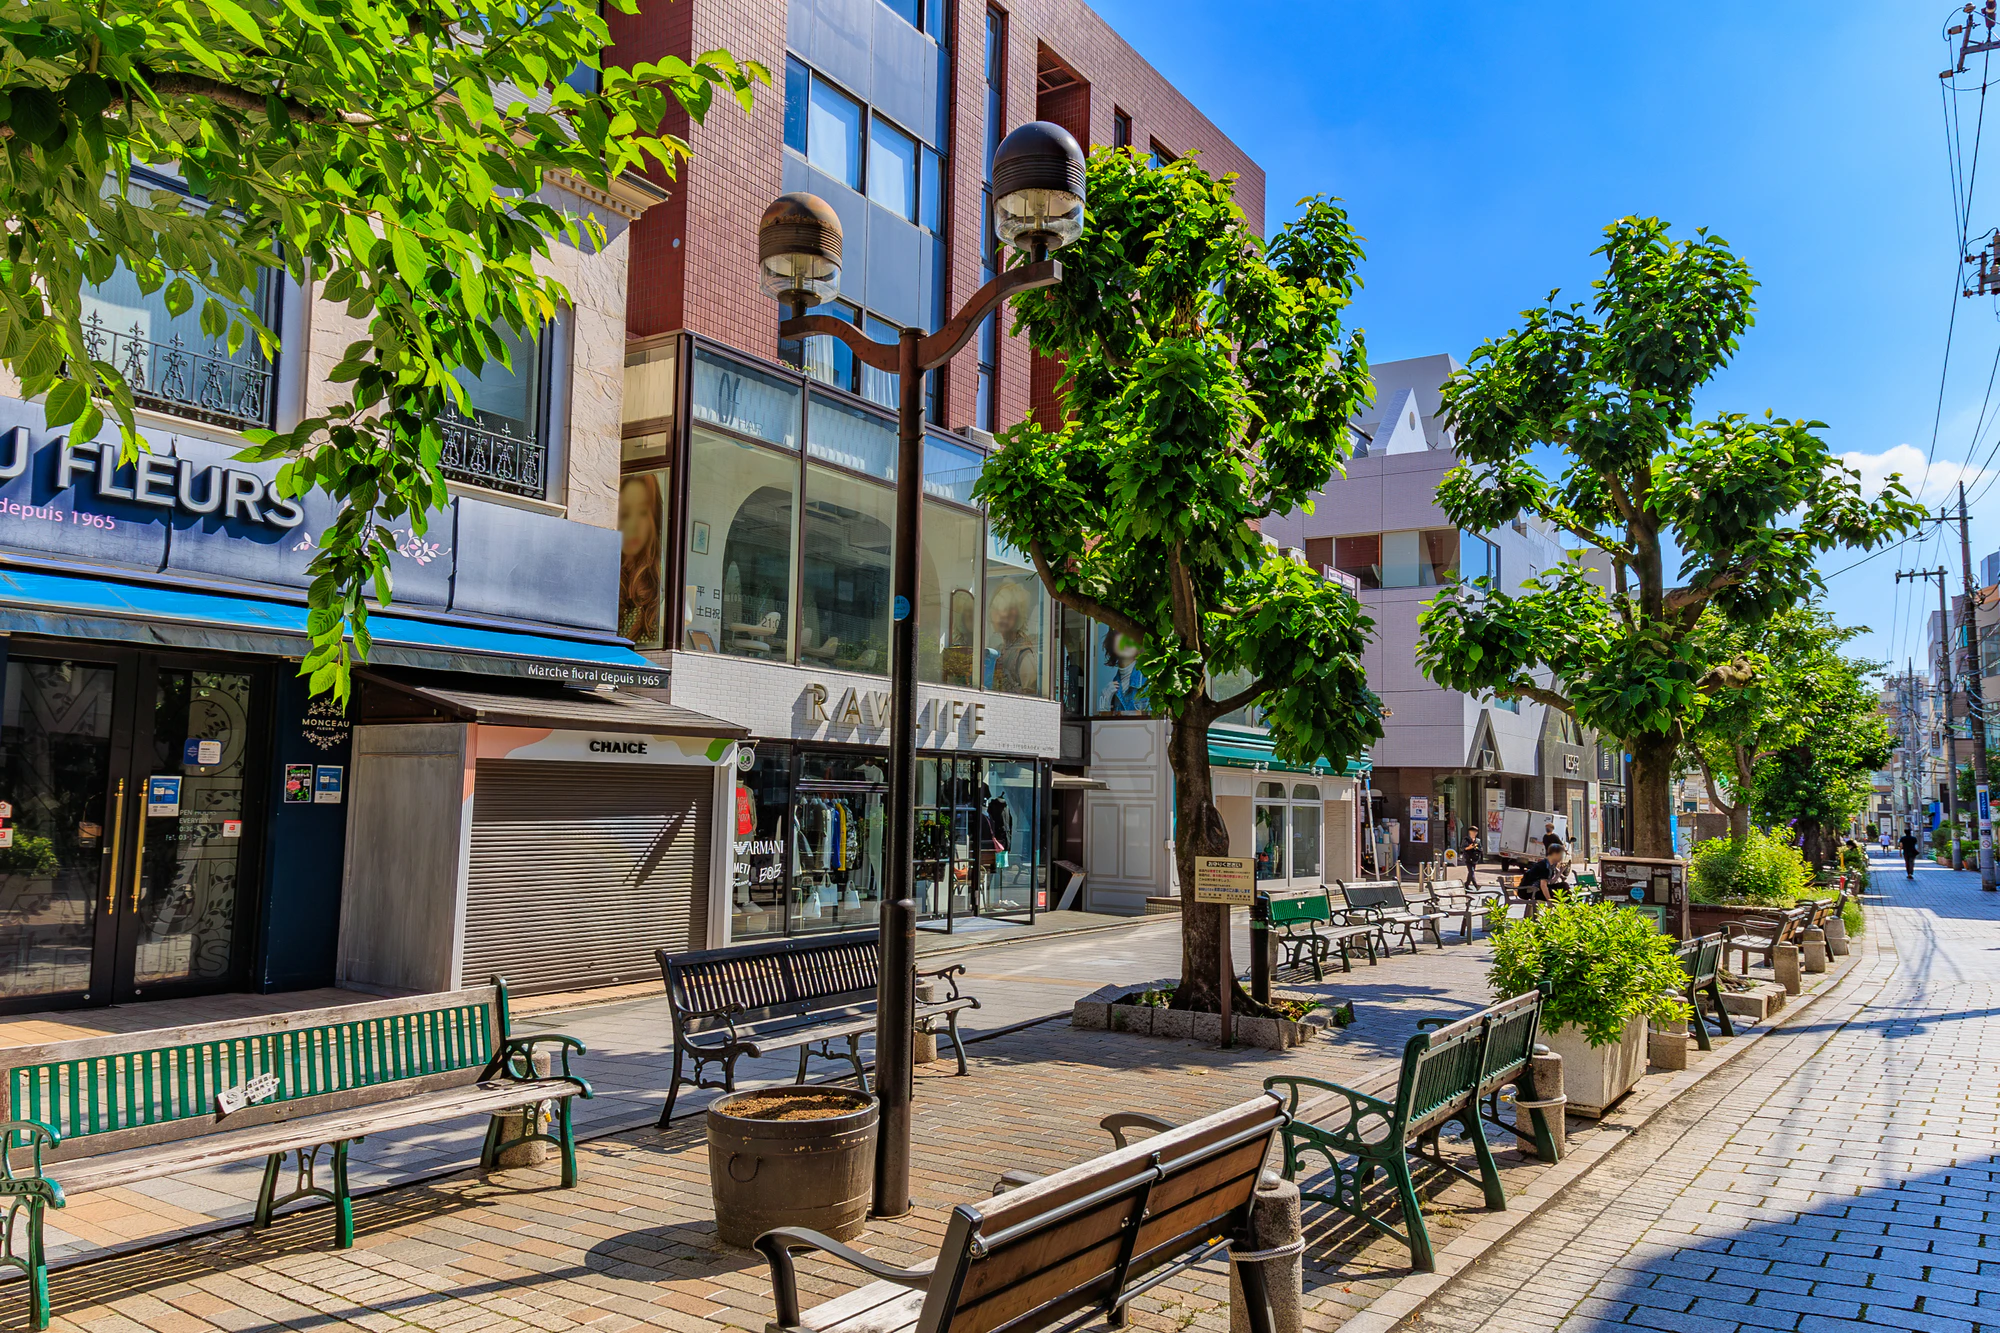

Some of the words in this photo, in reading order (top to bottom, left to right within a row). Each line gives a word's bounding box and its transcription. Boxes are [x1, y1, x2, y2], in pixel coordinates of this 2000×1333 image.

[738, 416, 764, 436] HAIR
[56, 435, 305, 528] FLEURS
[0, 498, 63, 523] depuis
[71, 510, 116, 531] 1965
[696, 605, 721, 620] 土日祝
[528, 664, 569, 678] Marche
[571, 667, 598, 681] floral
[600, 671, 634, 685] depuis
[636, 674, 660, 686] 1965
[805, 682, 892, 728] RAW
[916, 698, 986, 736] IFE
[301, 718, 350, 728] MONCEAU
[589, 740, 648, 755] CHAICE
[746, 839, 784, 855] ARMANI
